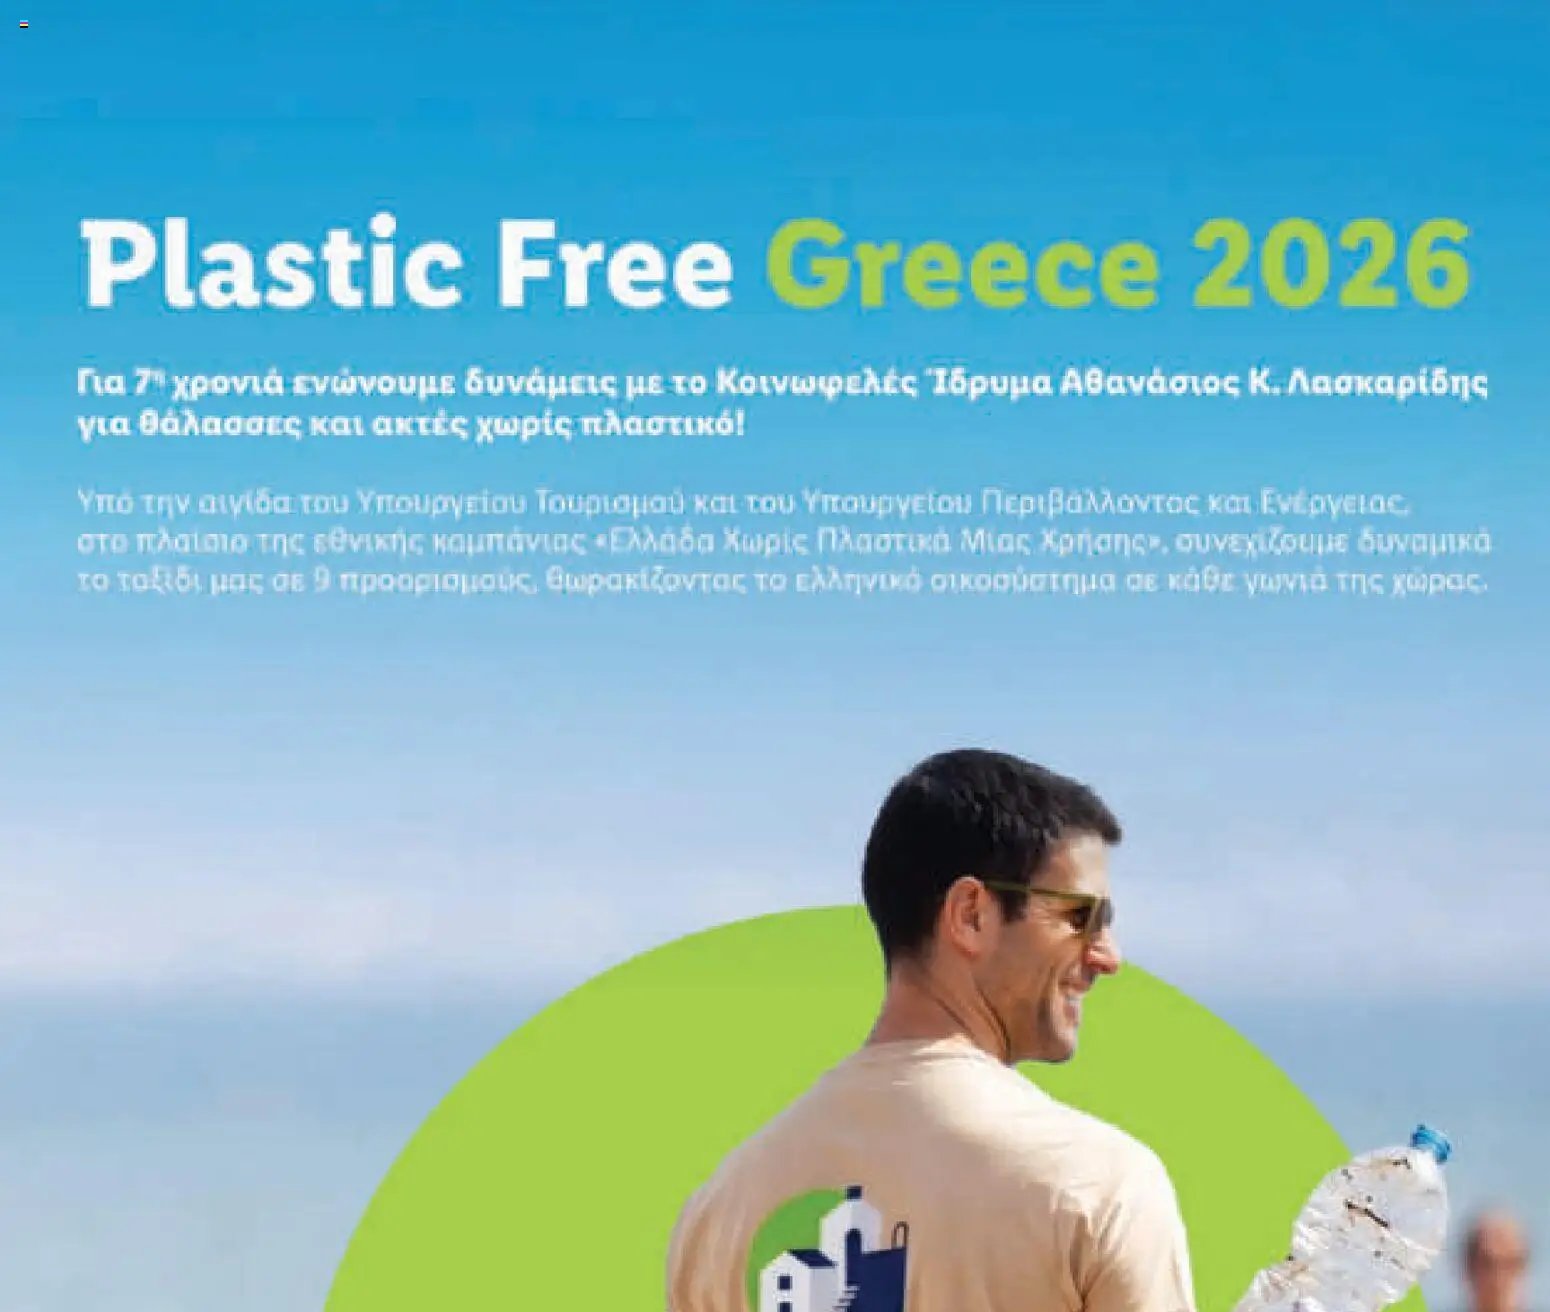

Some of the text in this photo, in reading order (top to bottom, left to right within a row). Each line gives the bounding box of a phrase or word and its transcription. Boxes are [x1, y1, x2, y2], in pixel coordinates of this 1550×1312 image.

[79, 211, 1471, 309] Plastic Free Greece 2026
[77, 367, 127, 397] Για
[170, 366, 286, 403] χρονιά
[291, 366, 456, 403] ενώνουμε
[464, 365, 620, 403] δυνάμεις
[625, 372, 665, 403] με
[670, 372, 709, 397] το
[714, 365, 920, 403] Κοινωφελές
[1059, 365, 1242, 400] Αθανάσιος
[1247, 365, 1282, 397] Κ.
[1283, 365, 1489, 403] Λασκαρίδης
[76, 407, 745, 445] για θάλασσες και ακτές χωρίς πλαστικό!
[77, 488, 135, 515] Υπό
[140, 493, 191, 521] την
[198, 487, 292, 521] αιγίδα
[300, 493, 350, 515] του
[356, 489, 528, 521] Υπουργείου
[535, 487, 685, 521] Τουρισμού
[694, 494, 738, 515] και
[744, 494, 796, 515] του
[801, 488, 972, 520] Υπουργείου
[982, 486, 1201, 520] Περιβάλλοντος
[1208, 494, 1252, 515] και
[76, 532, 130, 555] στο
[135, 526, 250, 555] πλαίσιο
[255, 533, 305, 558] της
[313, 526, 424, 559] εθνικής
[432, 528, 588, 557] καμπάνιας
[723, 527, 809, 559] Χωρίς
[817, 526, 952, 555] Πλαστικά
[960, 527, 1031, 556] Μίας
[1175, 525, 1349, 559] συνεχίζουμε
[1357, 526, 1493, 557] δυναμικά
[77, 564, 1488, 597] το ταξίδι μας σε 9 προορισμούς, θωρακίζοντας το ελληνικό οικοσύστημα σε κάθε γωνιά της χώρας.
